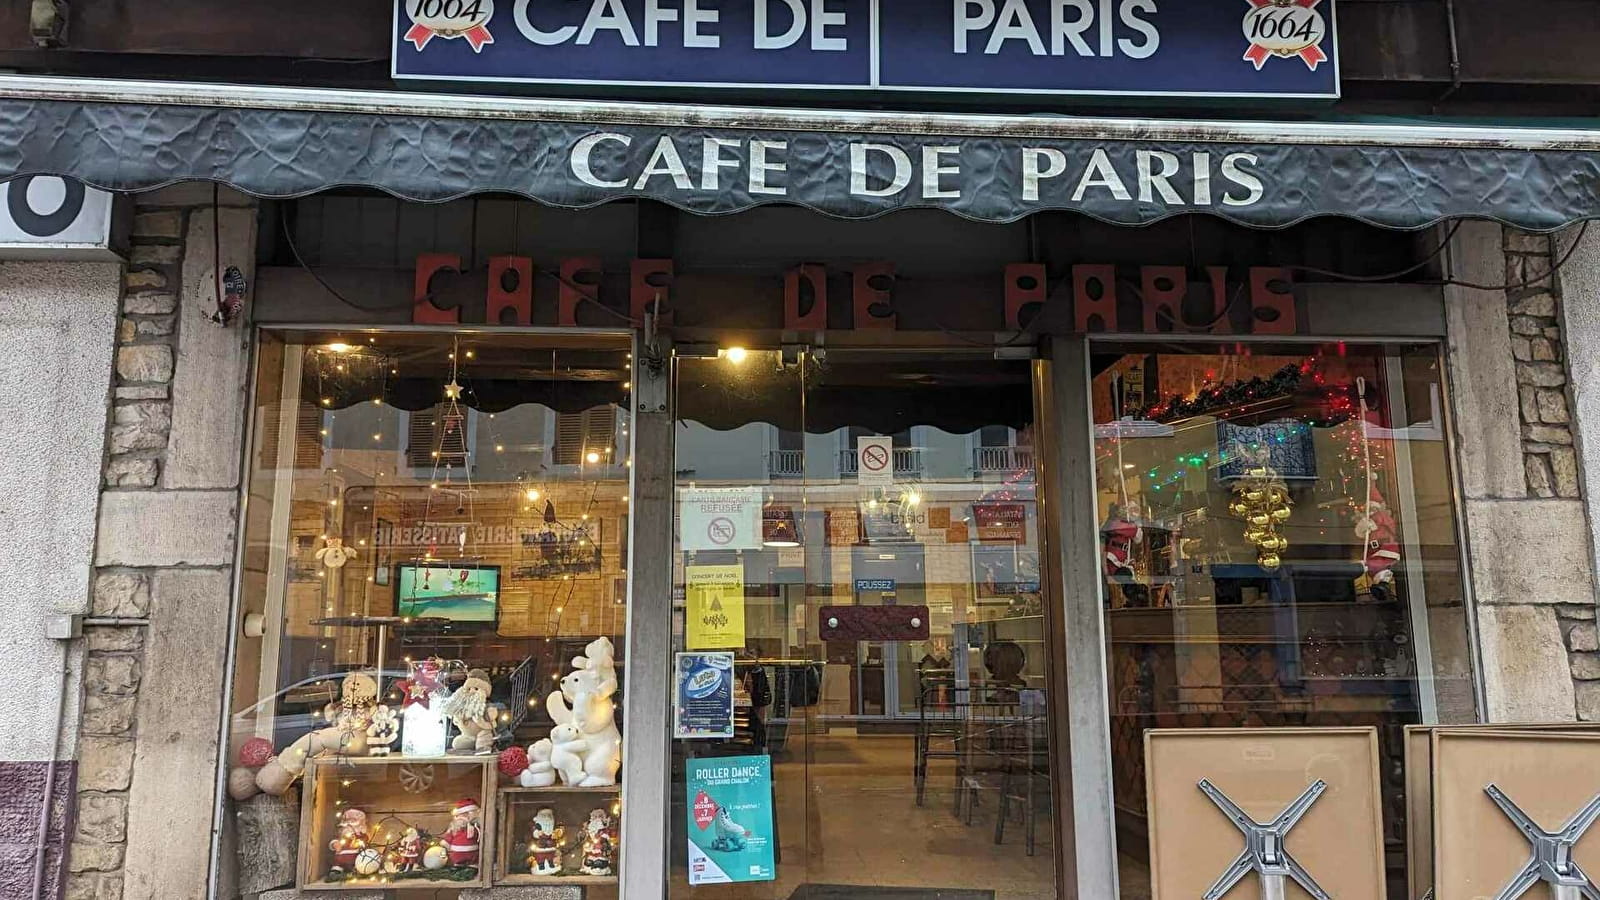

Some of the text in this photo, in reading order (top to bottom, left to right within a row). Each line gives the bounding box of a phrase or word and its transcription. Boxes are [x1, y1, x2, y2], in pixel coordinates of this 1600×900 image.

[513, 0, 1160, 59] CAFE DE PARIS
[1250, 12, 1318, 41] 1664
[570, 132, 1264, 207] CAFE DE PARIS
[413, 254, 1296, 334] CAFE DE PARIS
[857, 580, 892, 590] POUSSEZ
[696, 766, 760, 779] ROLLER DANCE
